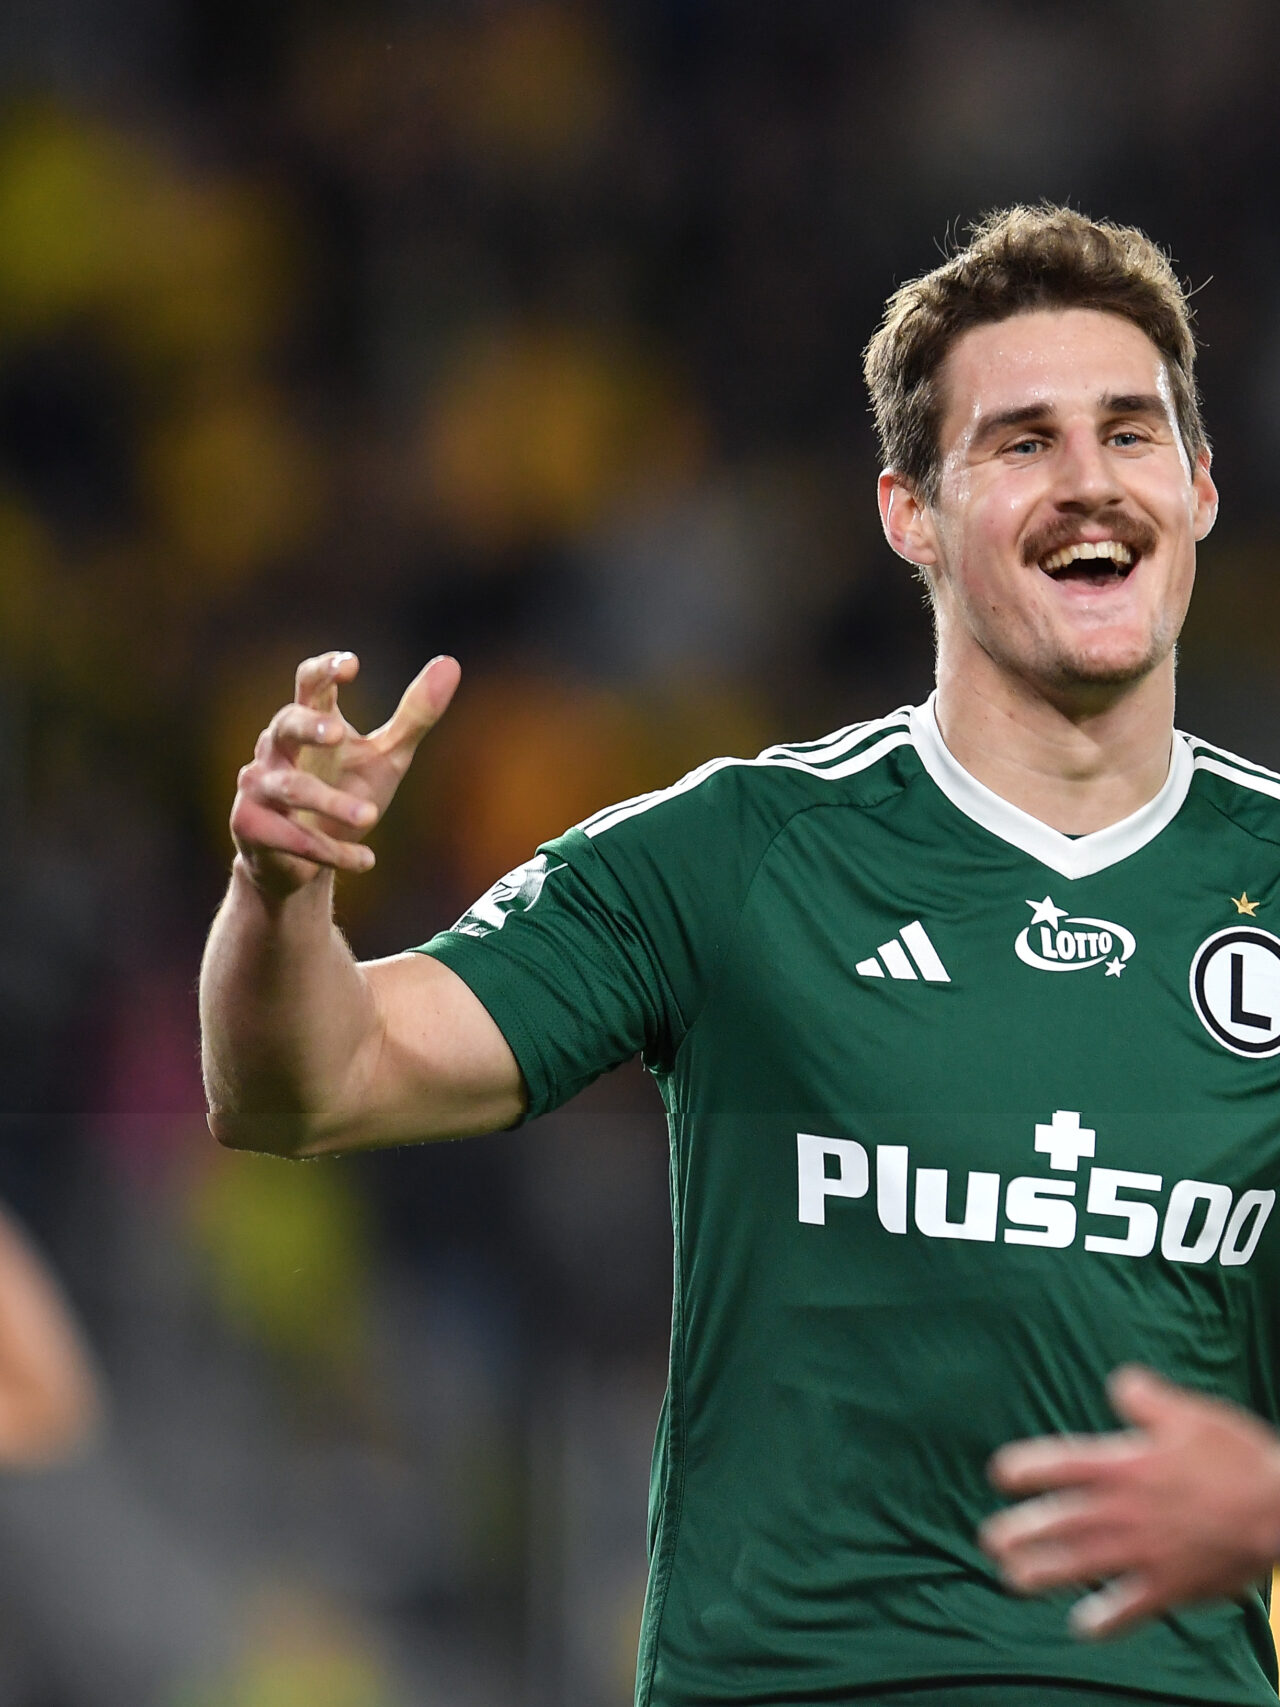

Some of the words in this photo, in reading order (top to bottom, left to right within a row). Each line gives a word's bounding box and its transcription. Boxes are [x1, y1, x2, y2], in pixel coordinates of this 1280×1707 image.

[1040, 926, 1113, 961] LOTTO
[1231, 953, 1271, 1031] L
[796, 1131, 1277, 1267] Plus500
